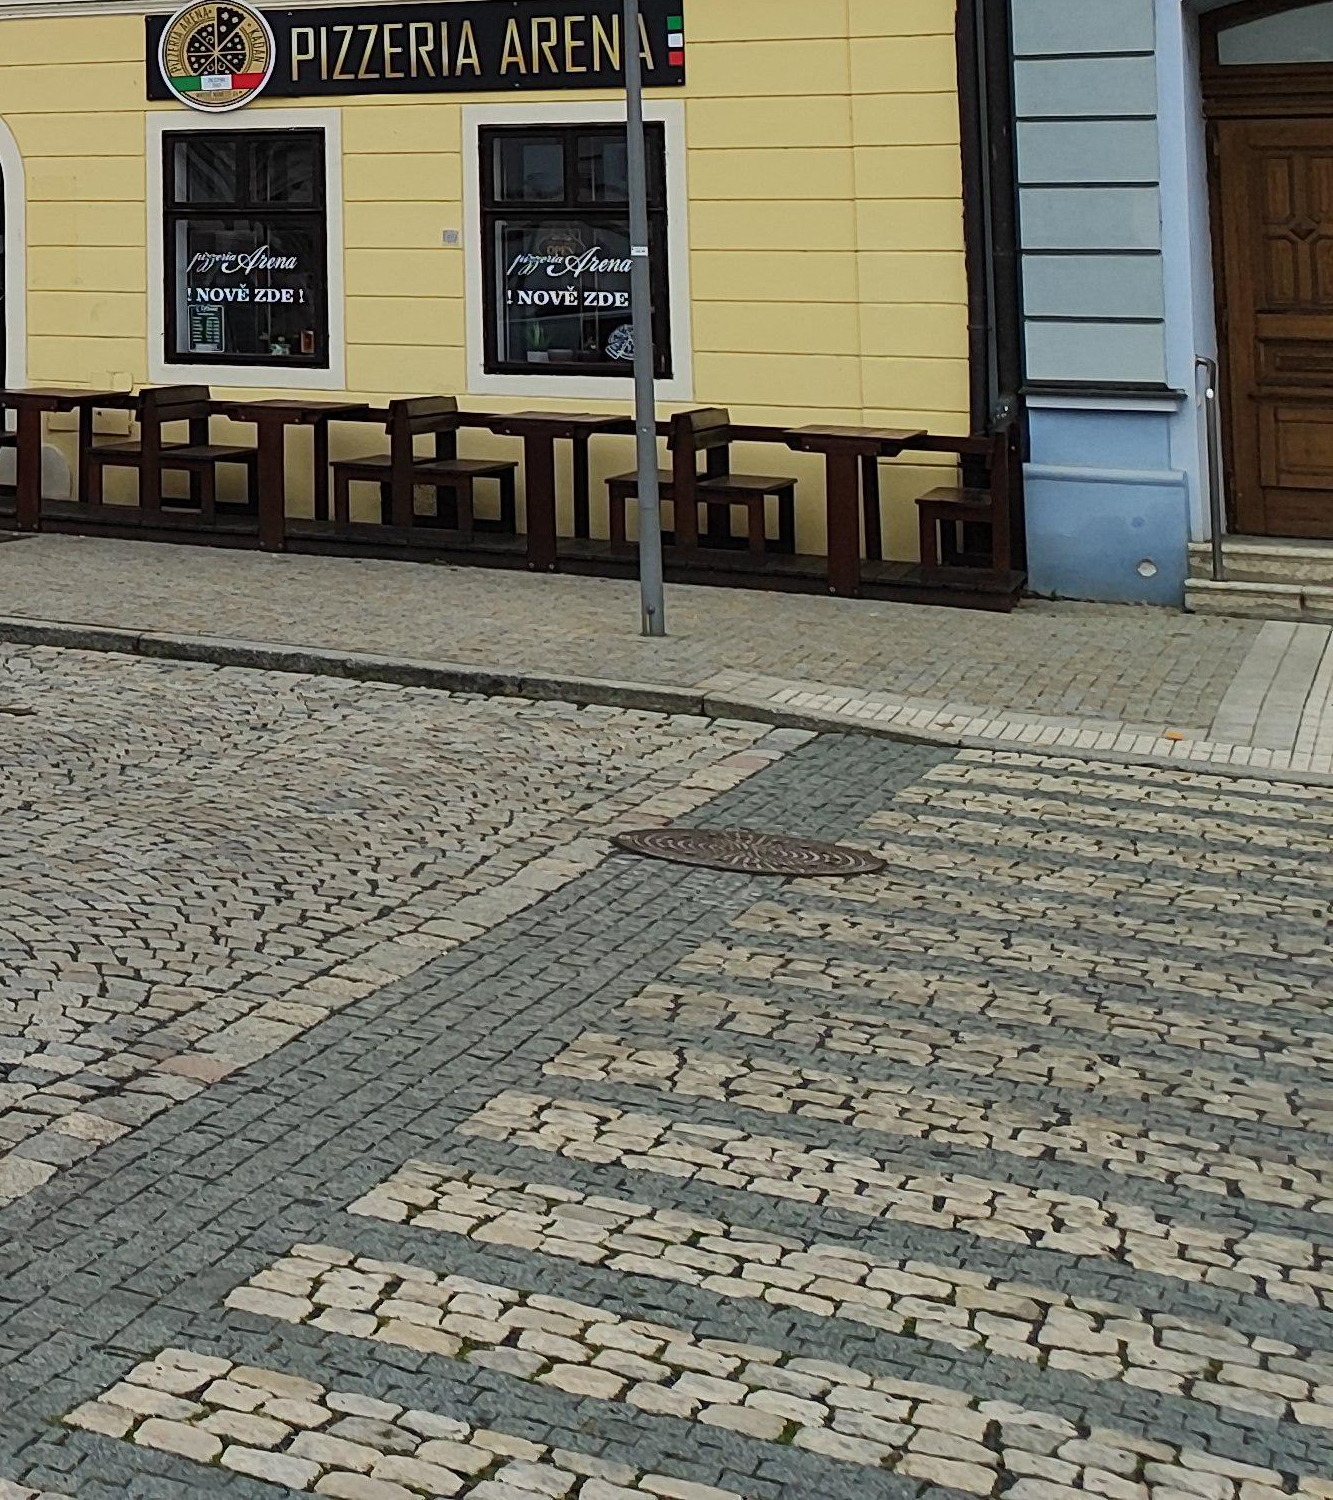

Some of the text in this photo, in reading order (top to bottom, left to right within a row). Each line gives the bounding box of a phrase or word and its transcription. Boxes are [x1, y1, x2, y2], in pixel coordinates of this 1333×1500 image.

[290, 12, 655, 82] PIZZERIA ARENA
[186, 245, 298, 275] pizzeria Arena
[507, 246, 633, 278] pizzeria Arena
[196, 283, 250, 302] NOVĚ
[254, 288, 294, 302] ZDE
[518, 286, 578, 305] NOVĚ
[584, 291, 629, 306] ZDE
